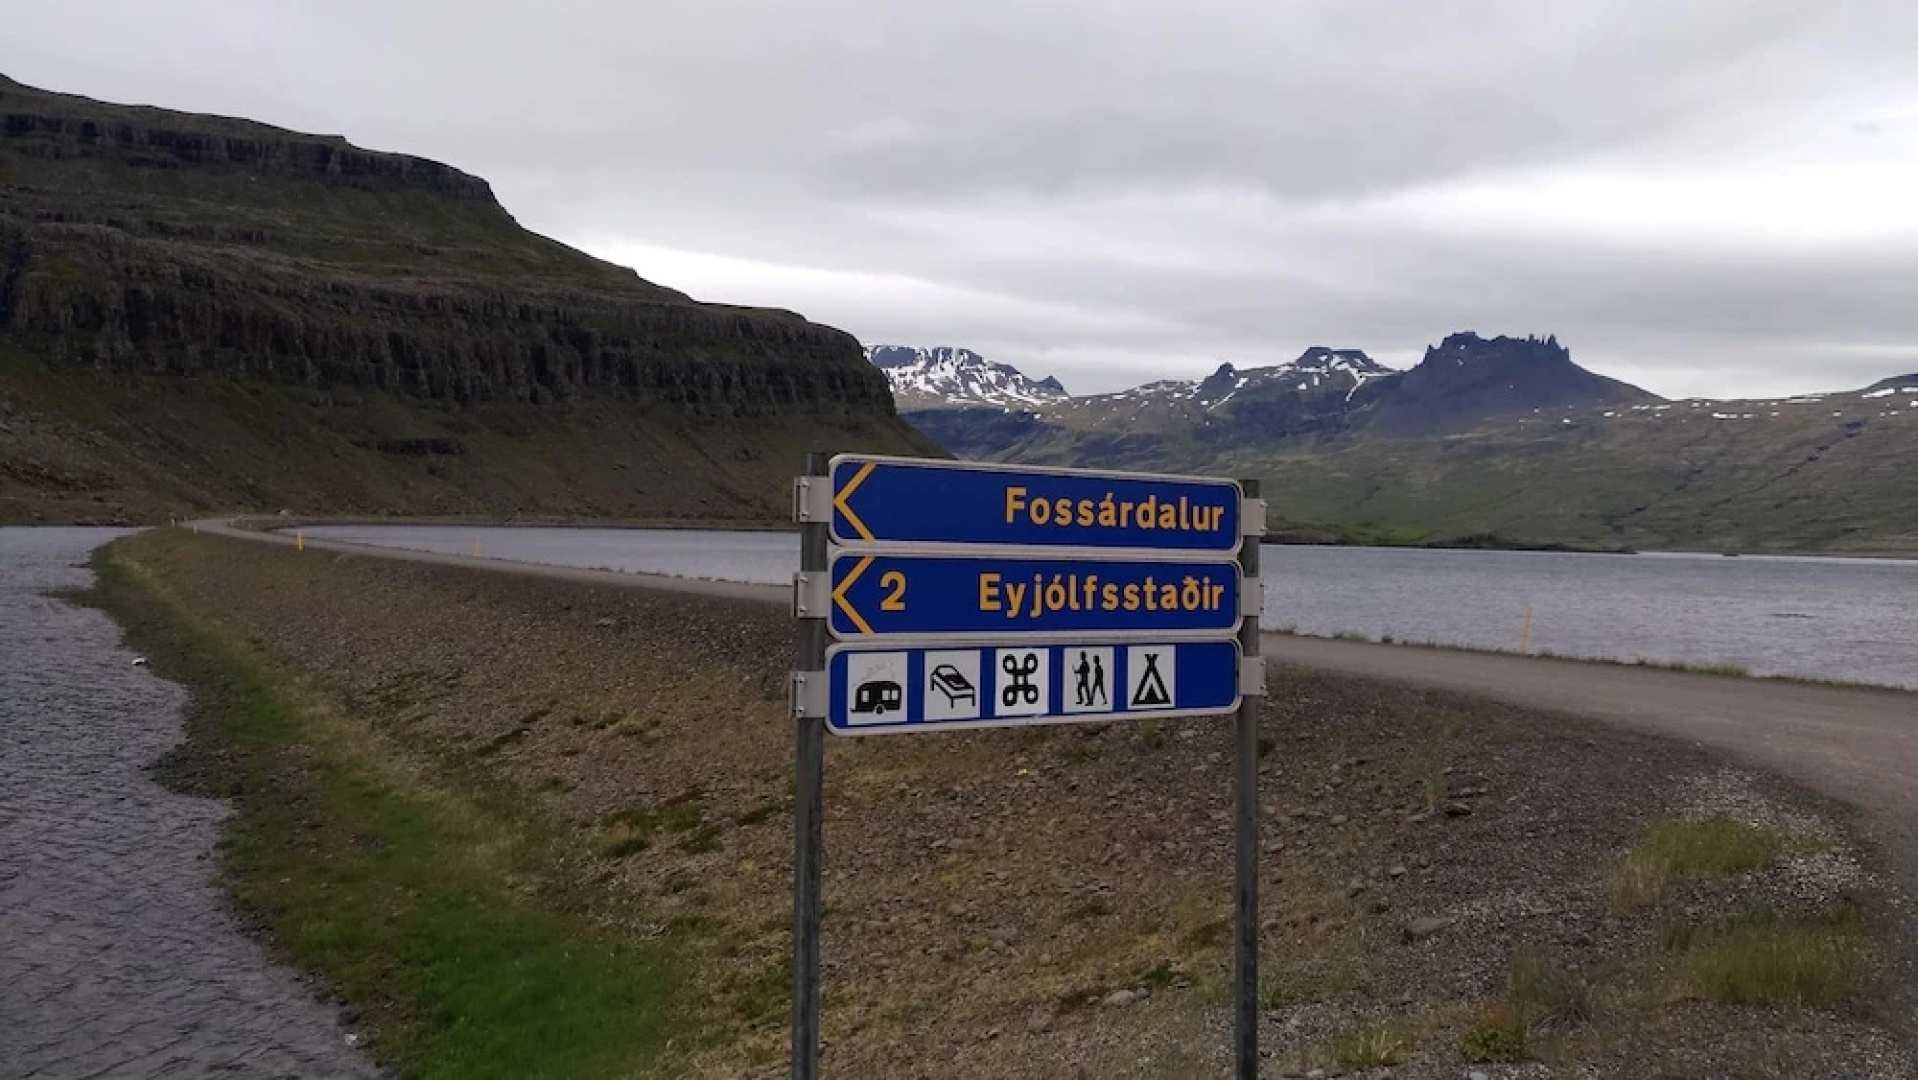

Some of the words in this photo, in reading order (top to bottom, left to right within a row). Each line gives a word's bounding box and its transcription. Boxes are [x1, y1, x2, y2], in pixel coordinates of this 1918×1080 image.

[1006, 487, 1225, 531] Fossárdalur
[880, 571, 907, 611] 2
[979, 573, 1225, 617] Eyjólfsstaðir
